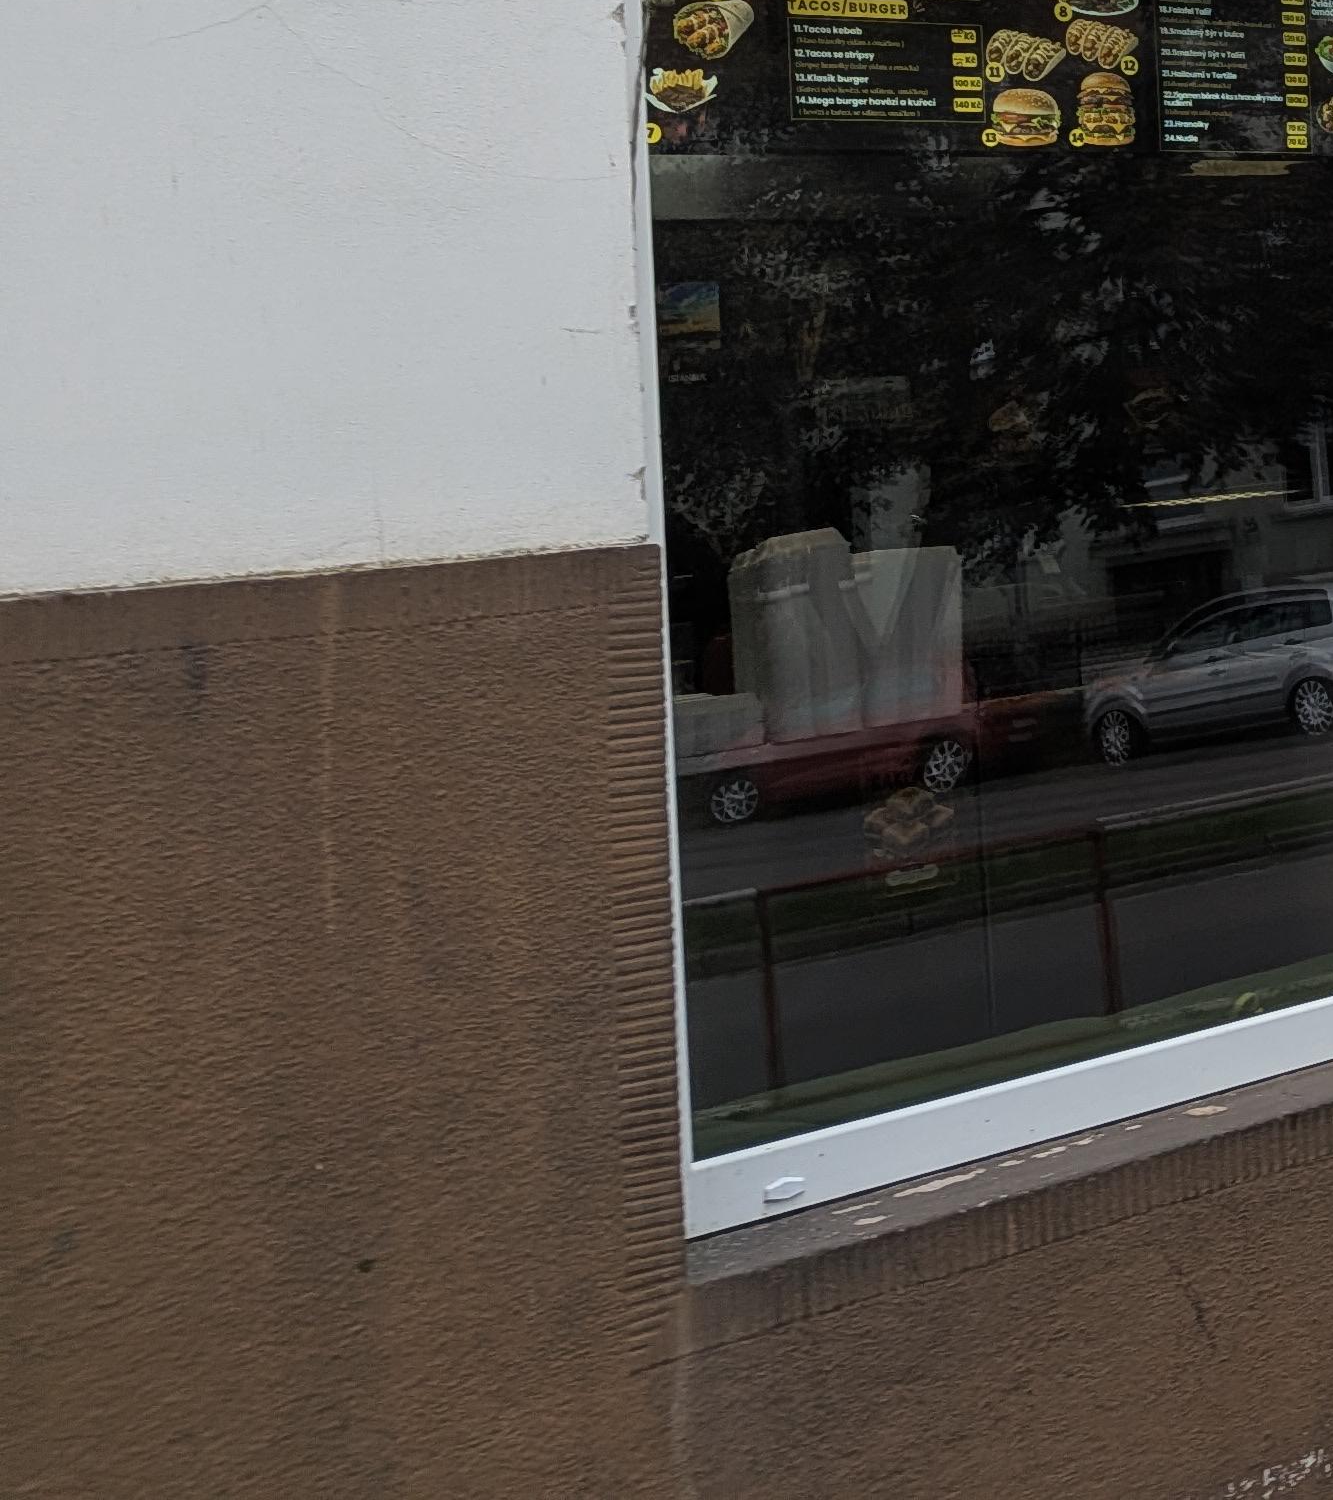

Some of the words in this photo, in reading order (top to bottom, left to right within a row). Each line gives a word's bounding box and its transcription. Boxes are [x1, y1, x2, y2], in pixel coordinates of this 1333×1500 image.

[788, 0, 907, 15] TACOS/BURGER
[1059, 6, 1067, 17] 8
[833, 26, 863, 35] kebab
[845, 50, 875, 62] stripsy
[1123, 61, 1135, 71] 12
[990, 68, 1001, 77] 11
[795, 73, 836, 83] 13.Klasik
[837, 75, 869, 85] burger
[796, 96, 835, 107] 14.Mega
[836, 97, 868, 107] burger
[985, 133, 997, 143] 13
[1072, 132, 1084, 142] 14
